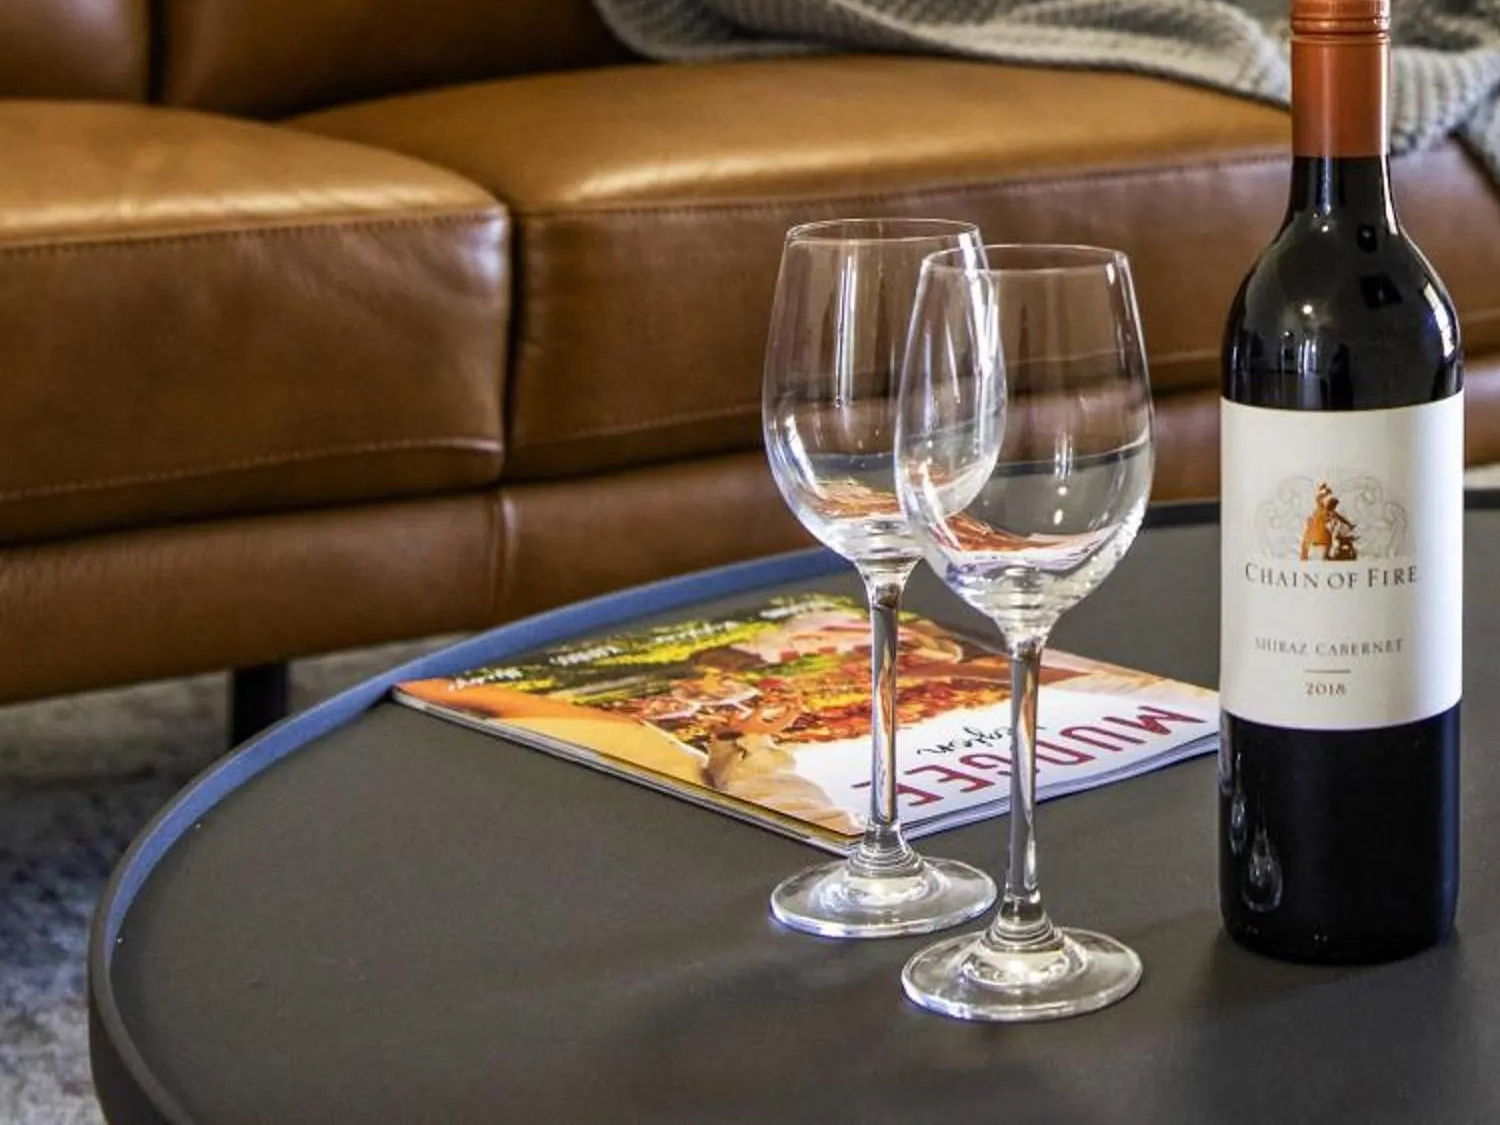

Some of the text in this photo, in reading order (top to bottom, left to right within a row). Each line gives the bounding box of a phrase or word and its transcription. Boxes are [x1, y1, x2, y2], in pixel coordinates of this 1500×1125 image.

[1245, 562, 1417, 589] CHAIN OF FIRE
[1255, 637, 1404, 656] SHIRAZ CABERNET
[1305, 682, 1346, 696] 2018
[852, 704, 1206, 807] MUDGEE
